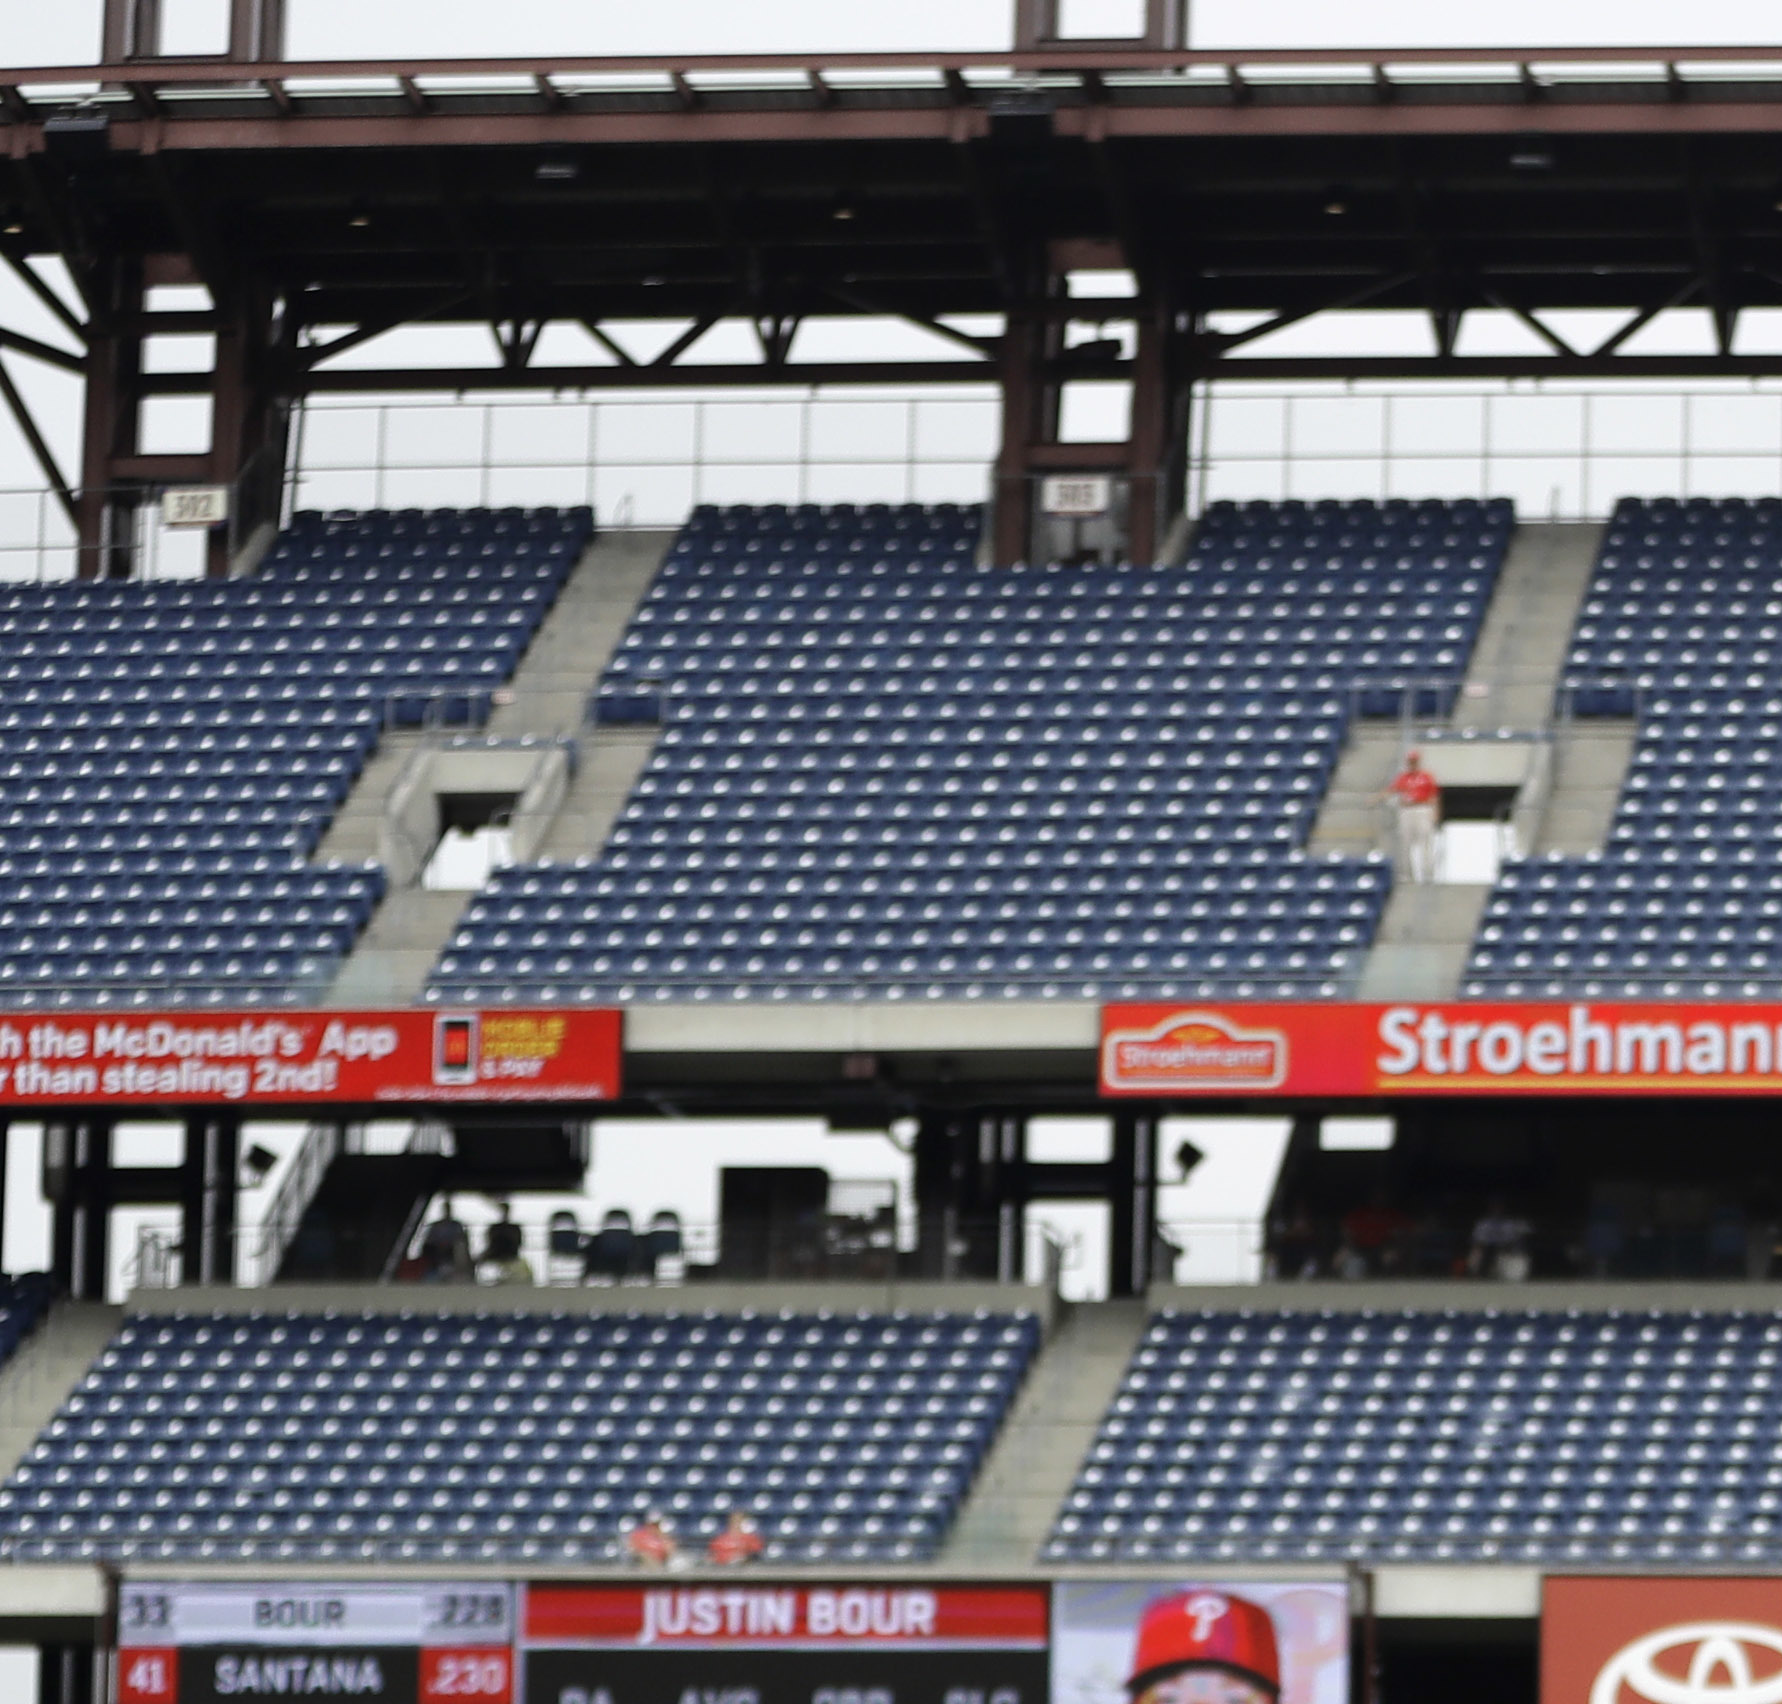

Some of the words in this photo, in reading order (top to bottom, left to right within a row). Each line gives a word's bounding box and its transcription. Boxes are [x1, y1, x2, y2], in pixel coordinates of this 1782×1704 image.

[29, 1023, 89, 1058] the
[94, 1020, 303, 1059] McDonald's
[317, 1019, 398, 1061] App
[14, 1061, 97, 1095] than
[102, 1059, 250, 1099] stealing
[253, 1059, 339, 1092] 2nd!
[256, 1599, 344, 1628] BOUR
[638, 1589, 796, 1645] JUSTIN
[807, 1589, 937, 1635] BOUR
[127, 1656, 167, 1694] 41
[214, 1654, 384, 1694] SANTANA
